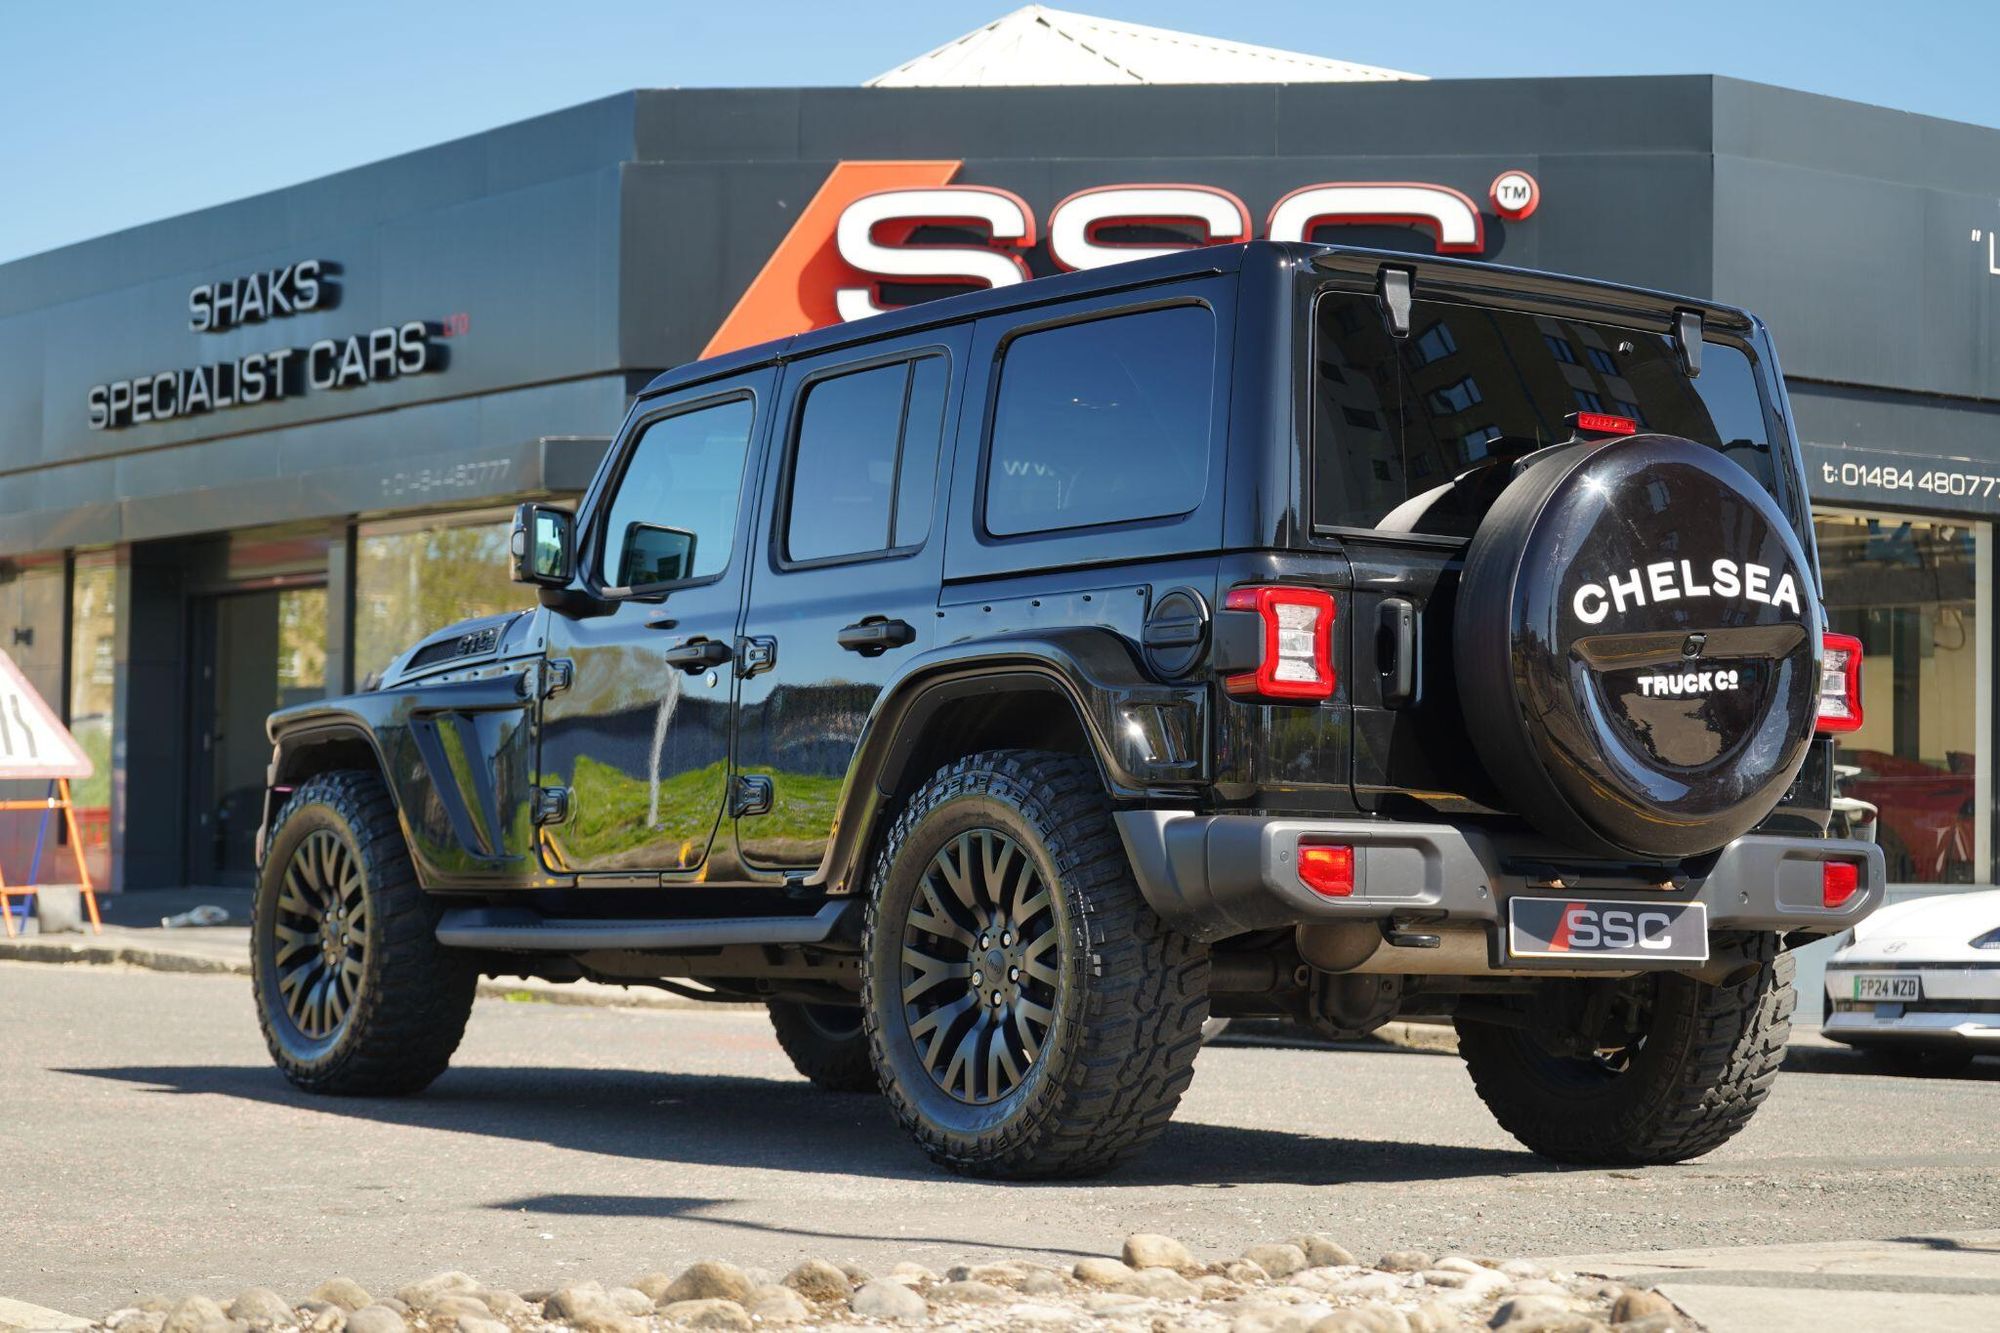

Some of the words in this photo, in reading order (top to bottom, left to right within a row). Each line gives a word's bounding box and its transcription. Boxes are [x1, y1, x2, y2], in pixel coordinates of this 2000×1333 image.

[1501, 185, 1526, 199] TM
[188, 259, 321, 333] SHAKS
[87, 347, 293, 431] SPECIALIST
[308, 320, 427, 390] CARS
[1841, 462, 1914, 491] 01484
[1918, 470, 2000, 500] 48077
[1573, 558, 1801, 624] CHELSEA
[1637, 671, 1714, 697] TRUCK
[1566, 909, 1673, 950] SSC
[1860, 979, 1888, 997] FP24
